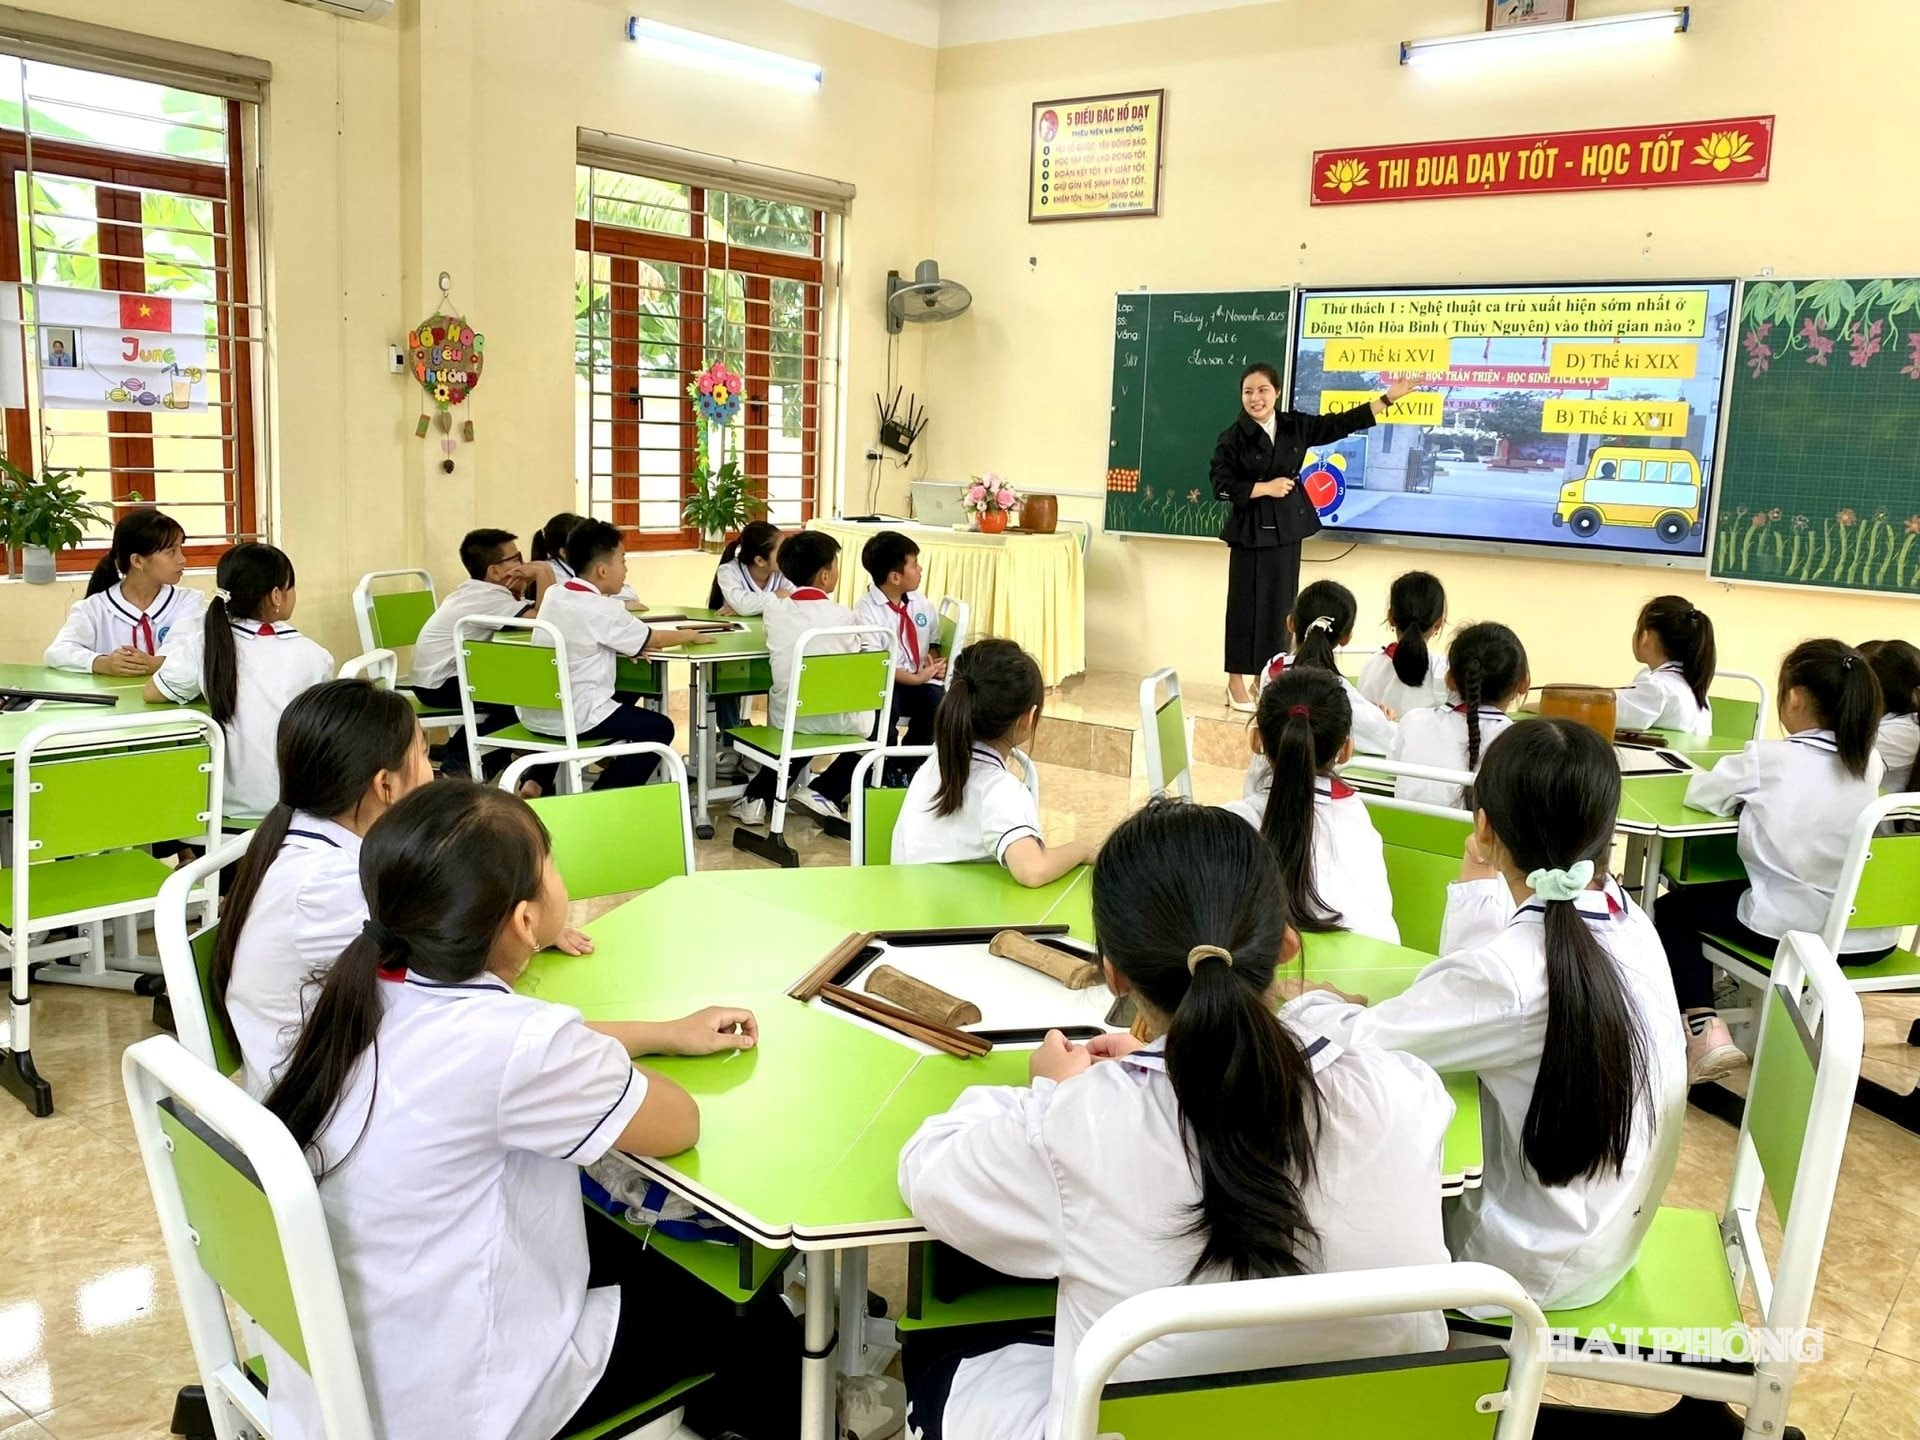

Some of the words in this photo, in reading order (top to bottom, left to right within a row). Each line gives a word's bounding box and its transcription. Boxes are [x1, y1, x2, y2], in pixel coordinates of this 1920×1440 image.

[1067, 113, 1072, 126] 5
[1097, 106, 1114, 123] BÁC
[1117, 102, 1130, 121] HỒ
[1132, 104, 1150, 122] DẠY
[1377, 159, 1410, 189] THI
[1416, 156, 1459, 186] ĐUA
[1466, 152, 1511, 190] DẠY
[1518, 139, 1559, 180] TỐT
[1581, 142, 1632, 184] HỌC
[1640, 130, 1684, 174] TỐT
[1350, 302, 1384, 314] thách
[1390, 302, 1396, 314] 1
[1409, 300, 1442, 316] Nghệ
[1446, 300, 1482, 316] thuật
[1486, 303, 1500, 313] ca
[1505, 298, 1526, 312] trù
[1531, 296, 1562, 312] xuất
[1566, 298, 1596, 314] hiện
[1601, 298, 1632, 312] sớm
[1636, 294, 1670, 312] nhất
[1310, 322, 1342, 336] Đông
[1347, 321, 1374, 334] Môn
[1379, 320, 1404, 333] Hòa
[1408, 320, 1439, 332] Bình
[1492, 320, 1550, 336] Nguyên)
[1555, 320, 1579, 333] vào
[1584, 318, 1612, 332] thời
[1617, 319, 1648, 335] gian
[1654, 318, 1682, 332] nào
[1688, 318, 1696, 332] ?
[1206, 331, 1228, 344] Unit
[1230, 334, 1238, 343] 6
[121, 336, 176, 364] June
[1188, 348, 1224, 365] Lesson
[1338, 349, 1356, 364] A)
[1360, 345, 1384, 362] Thế
[1405, 349, 1435, 363] XVI
[1566, 354, 1586, 371] D)
[1590, 350, 1620, 368] Thế
[1645, 354, 1680, 369] XIX
[1506, 372, 1526, 386] HỌC
[1528, 372, 1551, 384] SINH
[1328, 400, 1344, 413] C)
[1394, 402, 1434, 416] XVIII
[1556, 410, 1574, 426] B)
[1579, 406, 1608, 424] Thế
[1318, 462, 1328, 472] 12
[1338, 486, 1344, 496] 3
